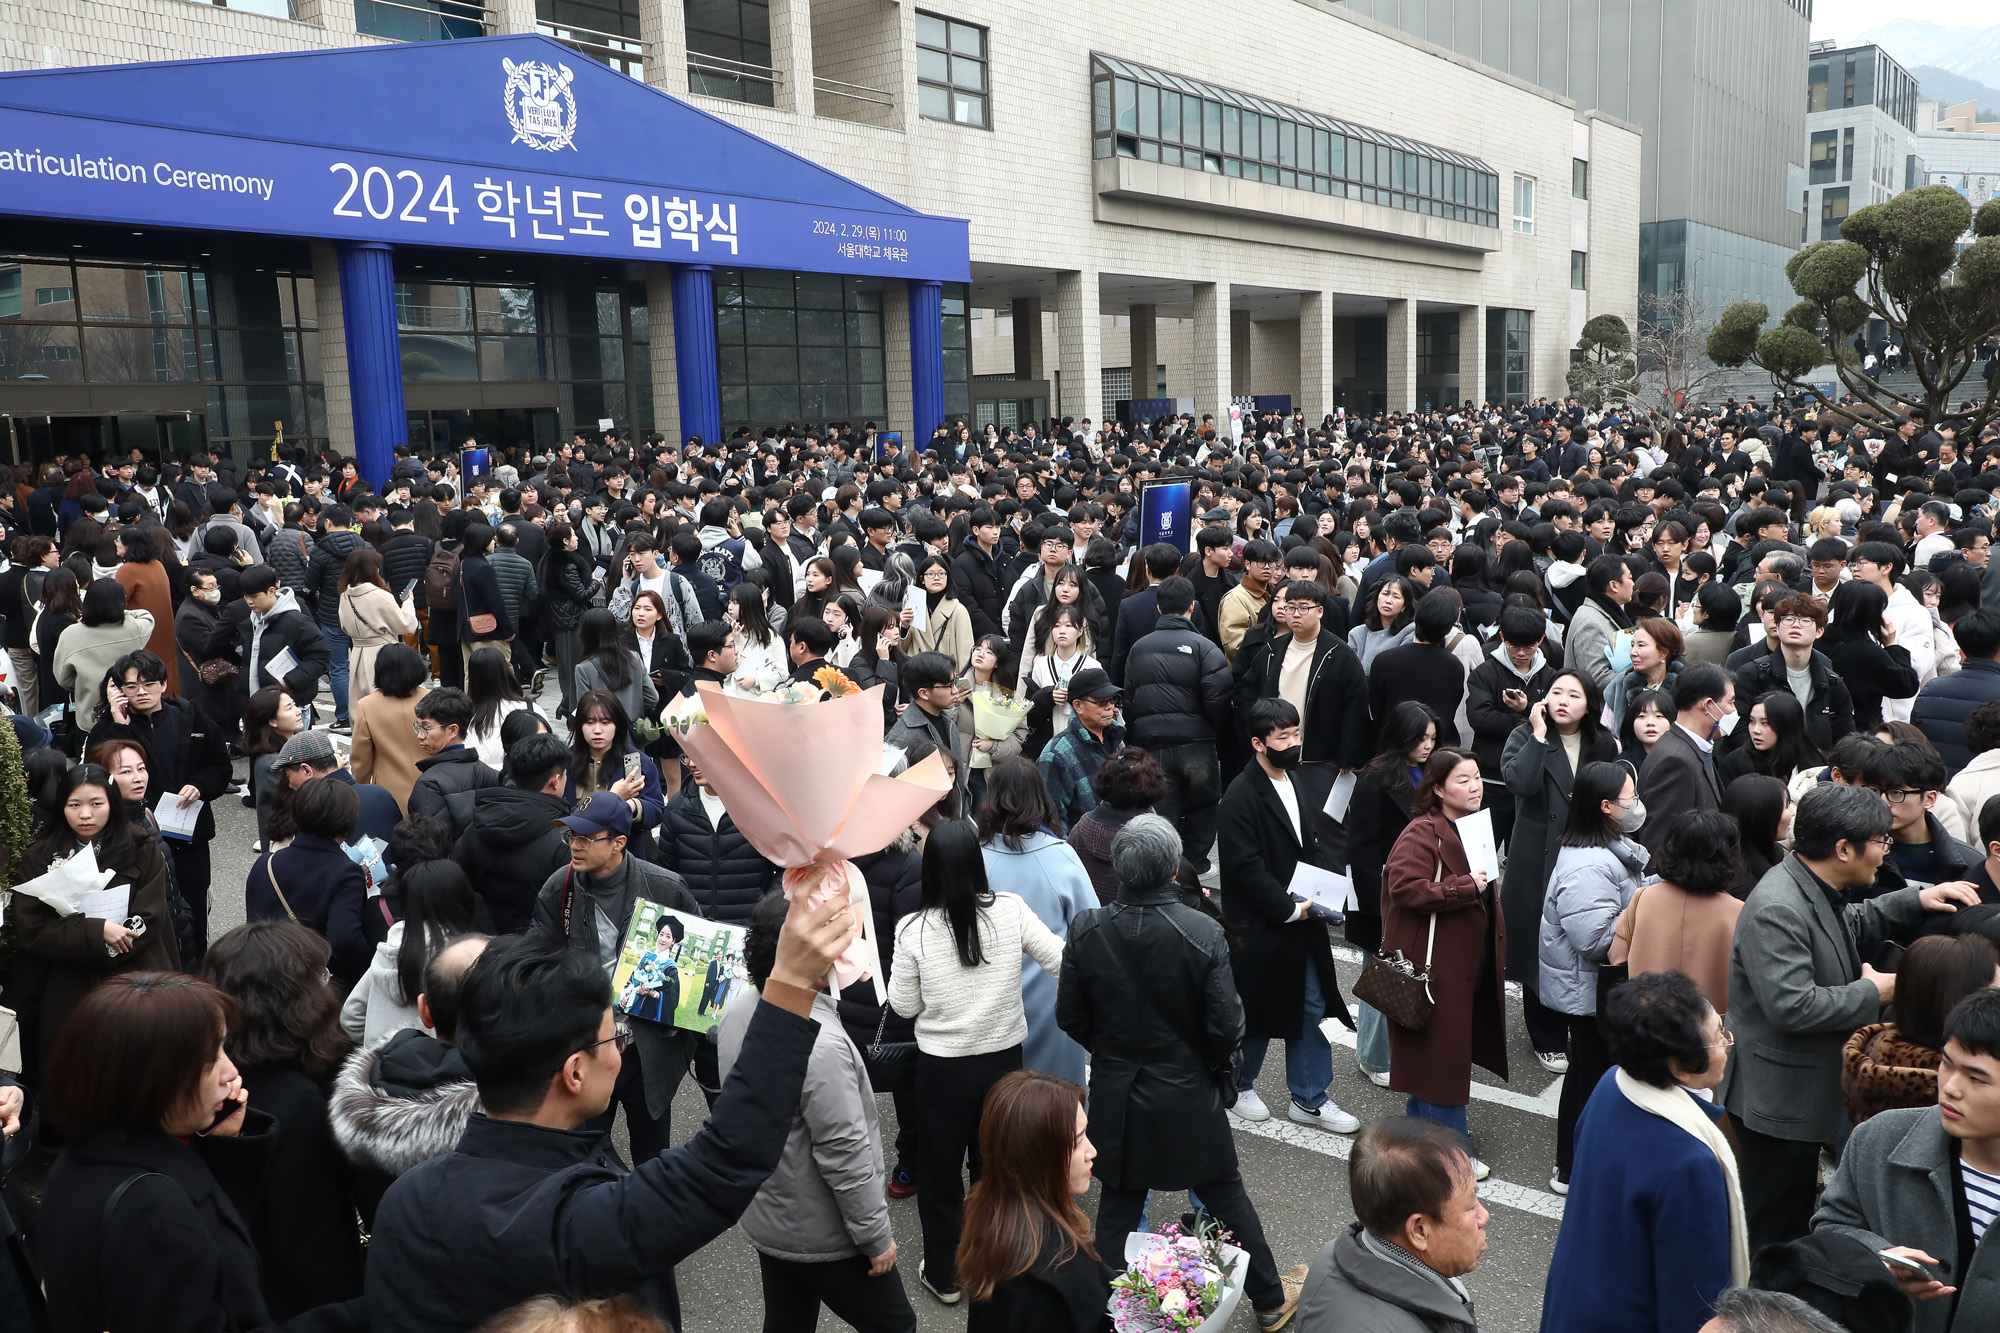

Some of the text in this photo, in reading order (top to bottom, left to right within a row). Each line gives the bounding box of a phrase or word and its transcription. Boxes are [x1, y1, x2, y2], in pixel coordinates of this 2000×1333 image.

[527, 106, 540, 116] VERI
[543, 109, 555, 118] LUX
[529, 116, 540, 125] TAS
[544, 118, 557, 127] MEA
[0, 148, 274, 201] atriculation Ceremony
[328, 162, 740, 256] 2024 학년도 입학식
[813, 221, 838, 236] 2024.
[840, 224, 849, 237] 2.
[884, 228, 907, 242] 11:00
[837, 243, 908, 262] 서울대학교 체육관
